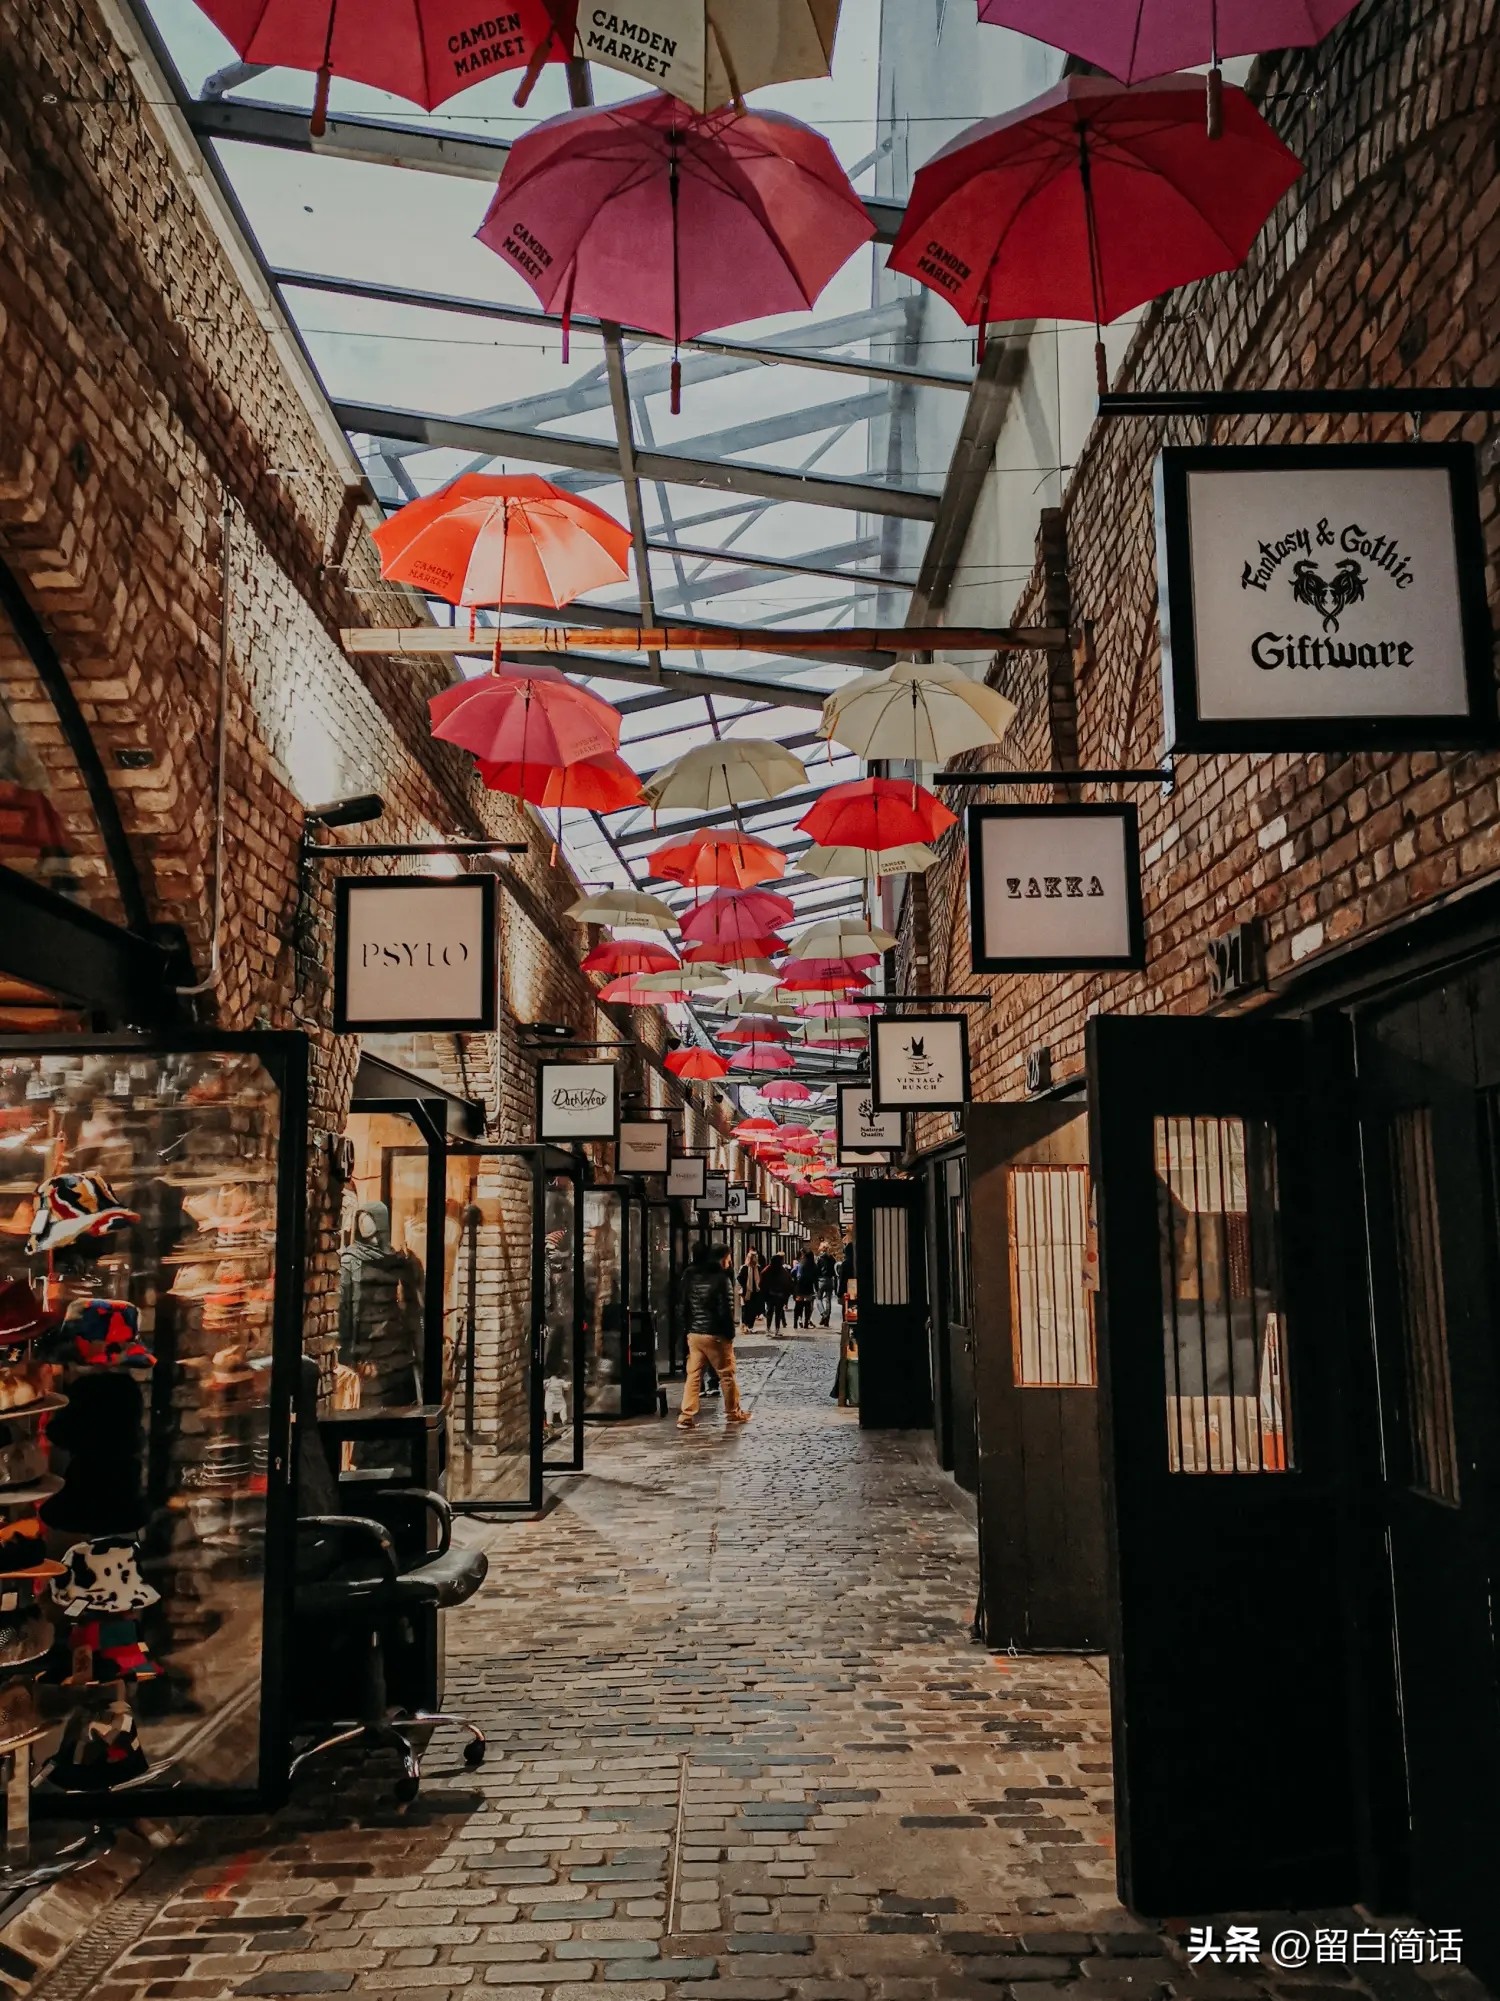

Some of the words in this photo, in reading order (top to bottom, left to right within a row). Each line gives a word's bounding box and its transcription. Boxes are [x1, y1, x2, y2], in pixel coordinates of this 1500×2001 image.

[447, 13, 522, 54] CAMDEN
[593, 9, 678, 57] CAMDEN
[453, 36, 526, 77] MARKET
[586, 31, 672, 78] MARKET
[502, 236, 543, 280] MARKET
[512, 222, 554, 268] CAMDEN
[926, 241, 972, 280] CAMDEN
[916, 255, 962, 295] MARKET
[413, 560, 455, 581] CAMDEN
[1241, 527, 1313, 592] Fantasy
[1315, 517, 1335, 547] &
[1340, 523, 1414, 589] Gothic
[407, 569, 449, 589] MARKET
[1251, 632, 1415, 670] Giftware
[883, 865, 907, 873] MARKET
[1006, 875, 1105, 899] ZAKKA
[363, 942, 468, 968] PSYLO
